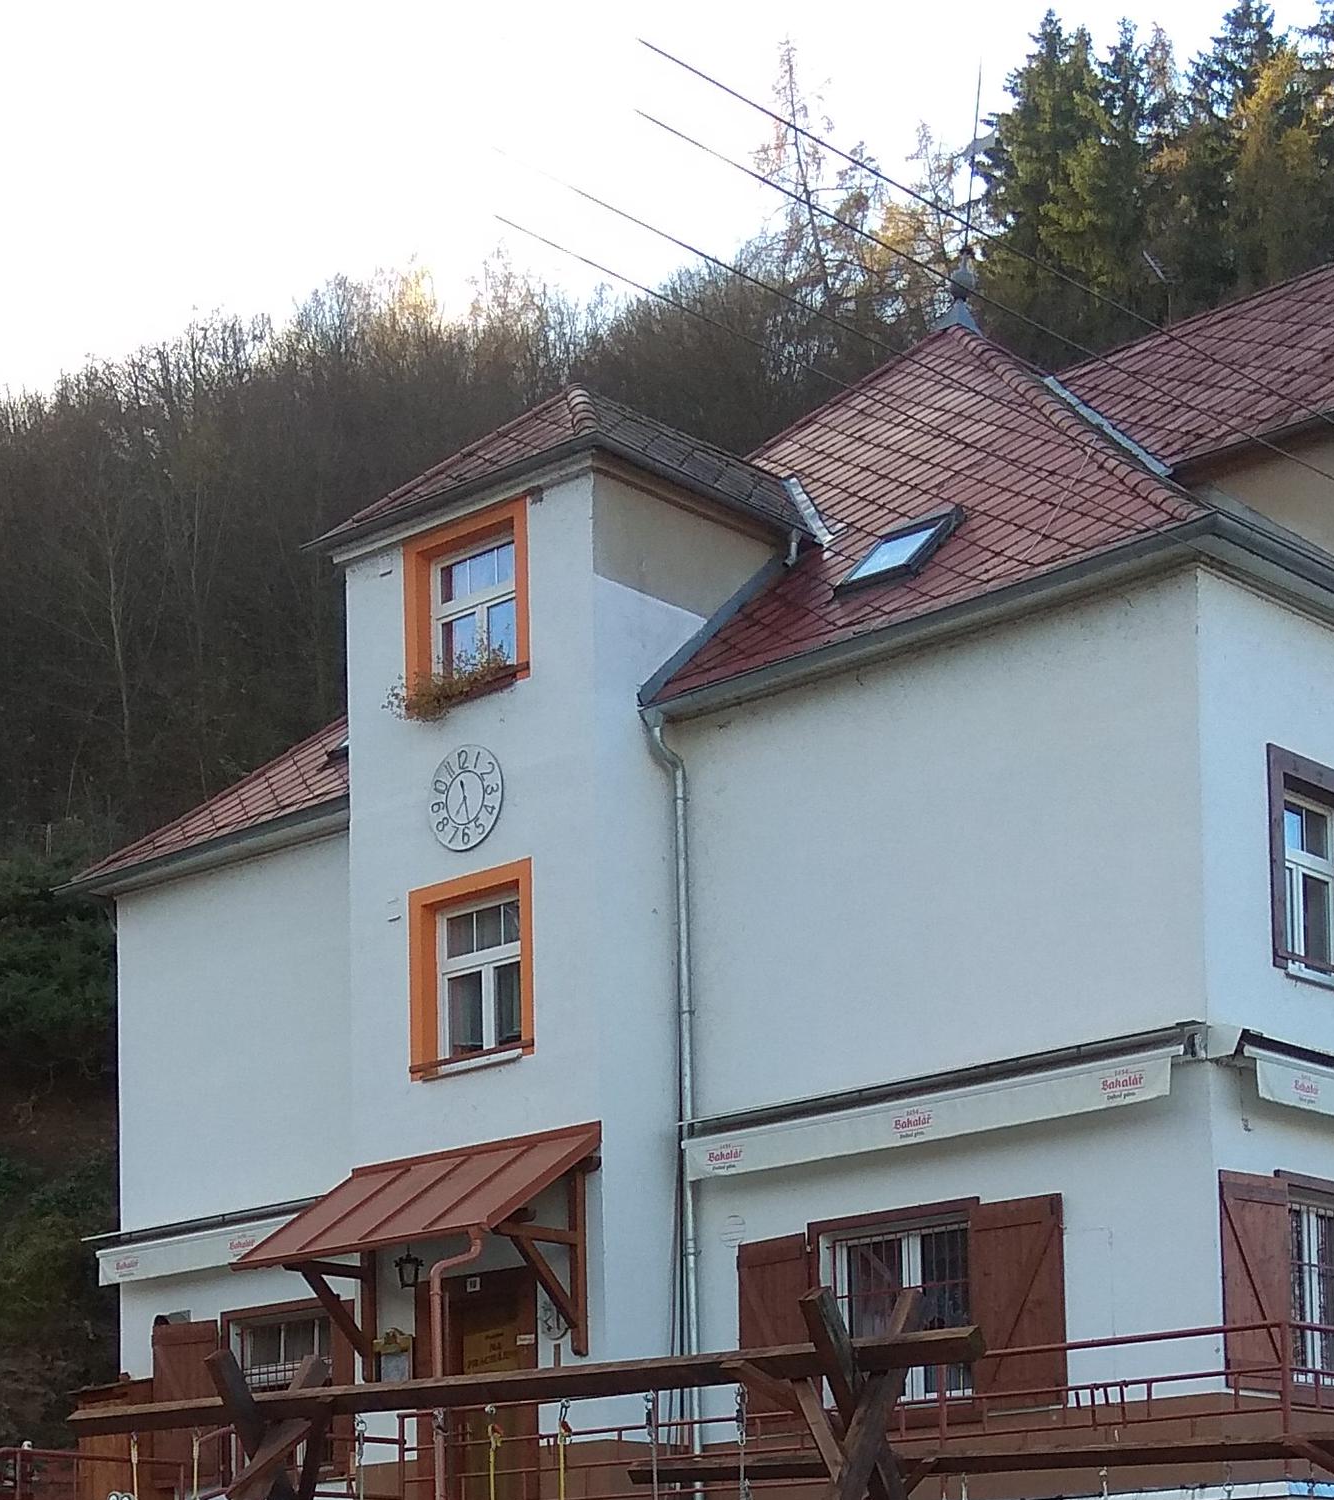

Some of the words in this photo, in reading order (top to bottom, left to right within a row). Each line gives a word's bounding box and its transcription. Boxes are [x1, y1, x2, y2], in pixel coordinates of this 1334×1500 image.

[457, 750, 469, 769] 12
[473, 751, 481, 769] 1
[444, 761, 455, 778] 11
[480, 761, 495, 781] 2
[433, 779, 448, 794] 10
[485, 783, 499, 795] 3
[431, 801, 445, 813] 9
[483, 803, 496, 815] 4
[436, 816, 449, 832] 8
[473, 817, 485, 835] 5
[448, 825, 459, 844] 7
[461, 826, 470, 845] 6
